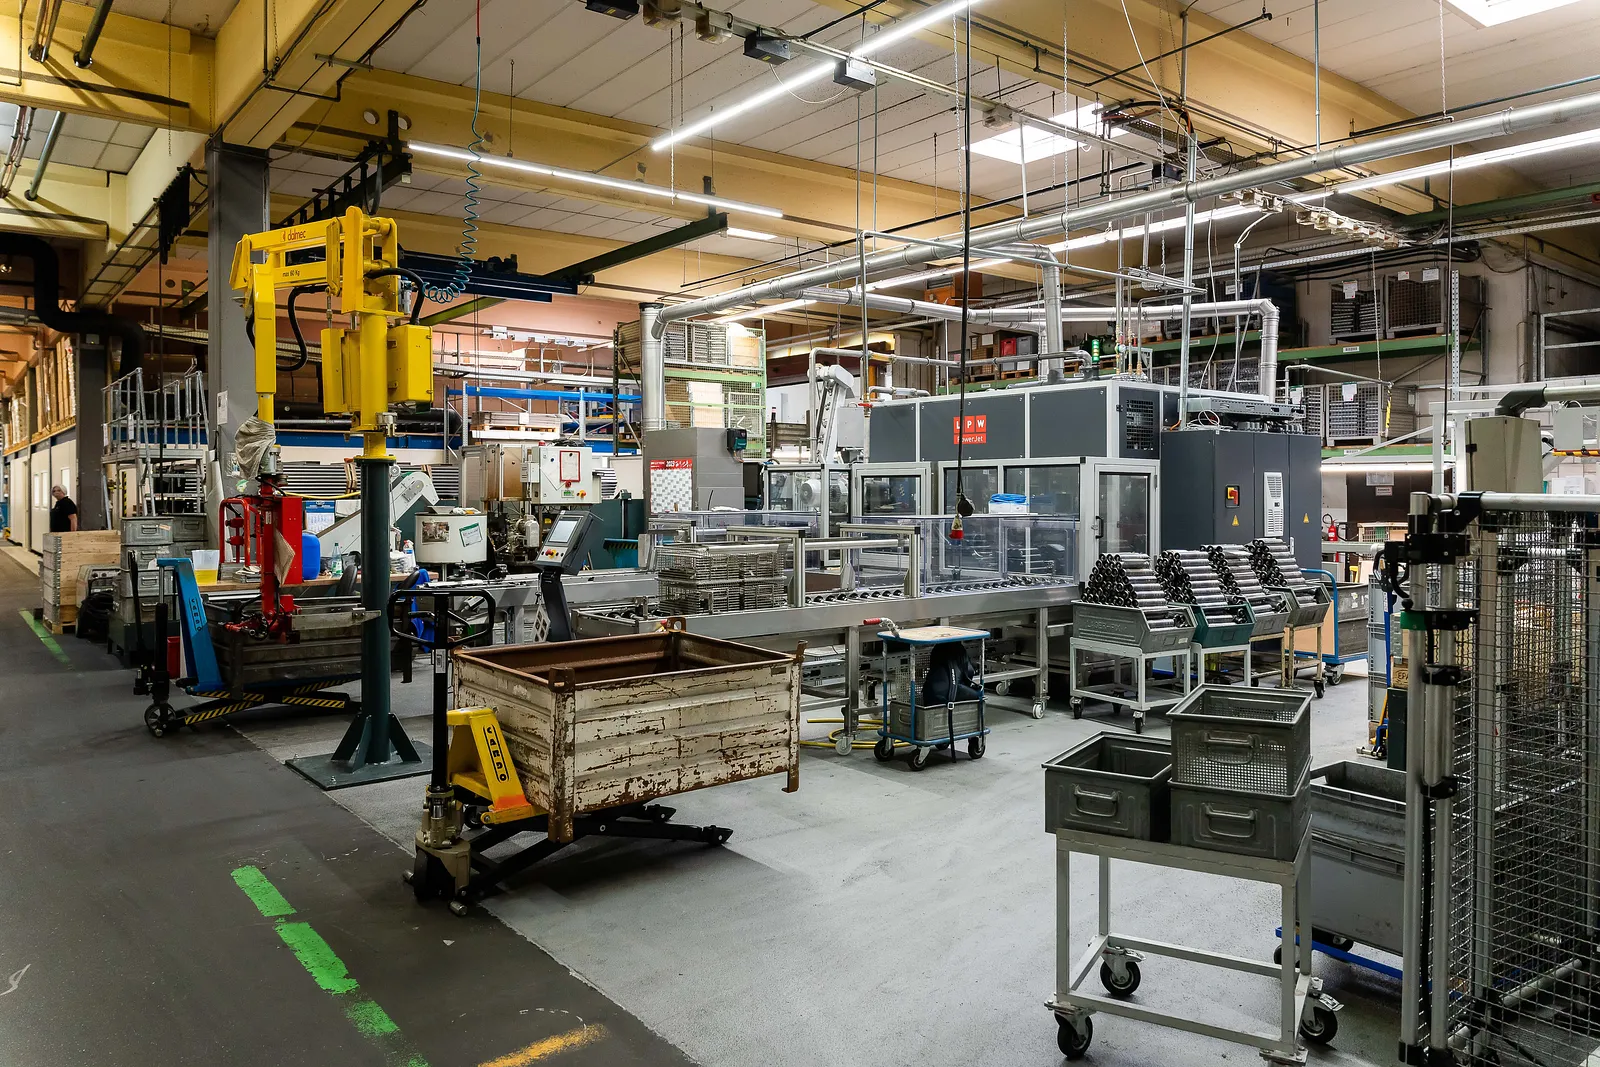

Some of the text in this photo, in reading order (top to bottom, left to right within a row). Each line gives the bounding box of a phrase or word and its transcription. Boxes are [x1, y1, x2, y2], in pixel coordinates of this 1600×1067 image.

[287, 229, 306, 241] dalmec
[956, 419, 985, 430] LPW
[486, 726, 507, 782] CARDO
